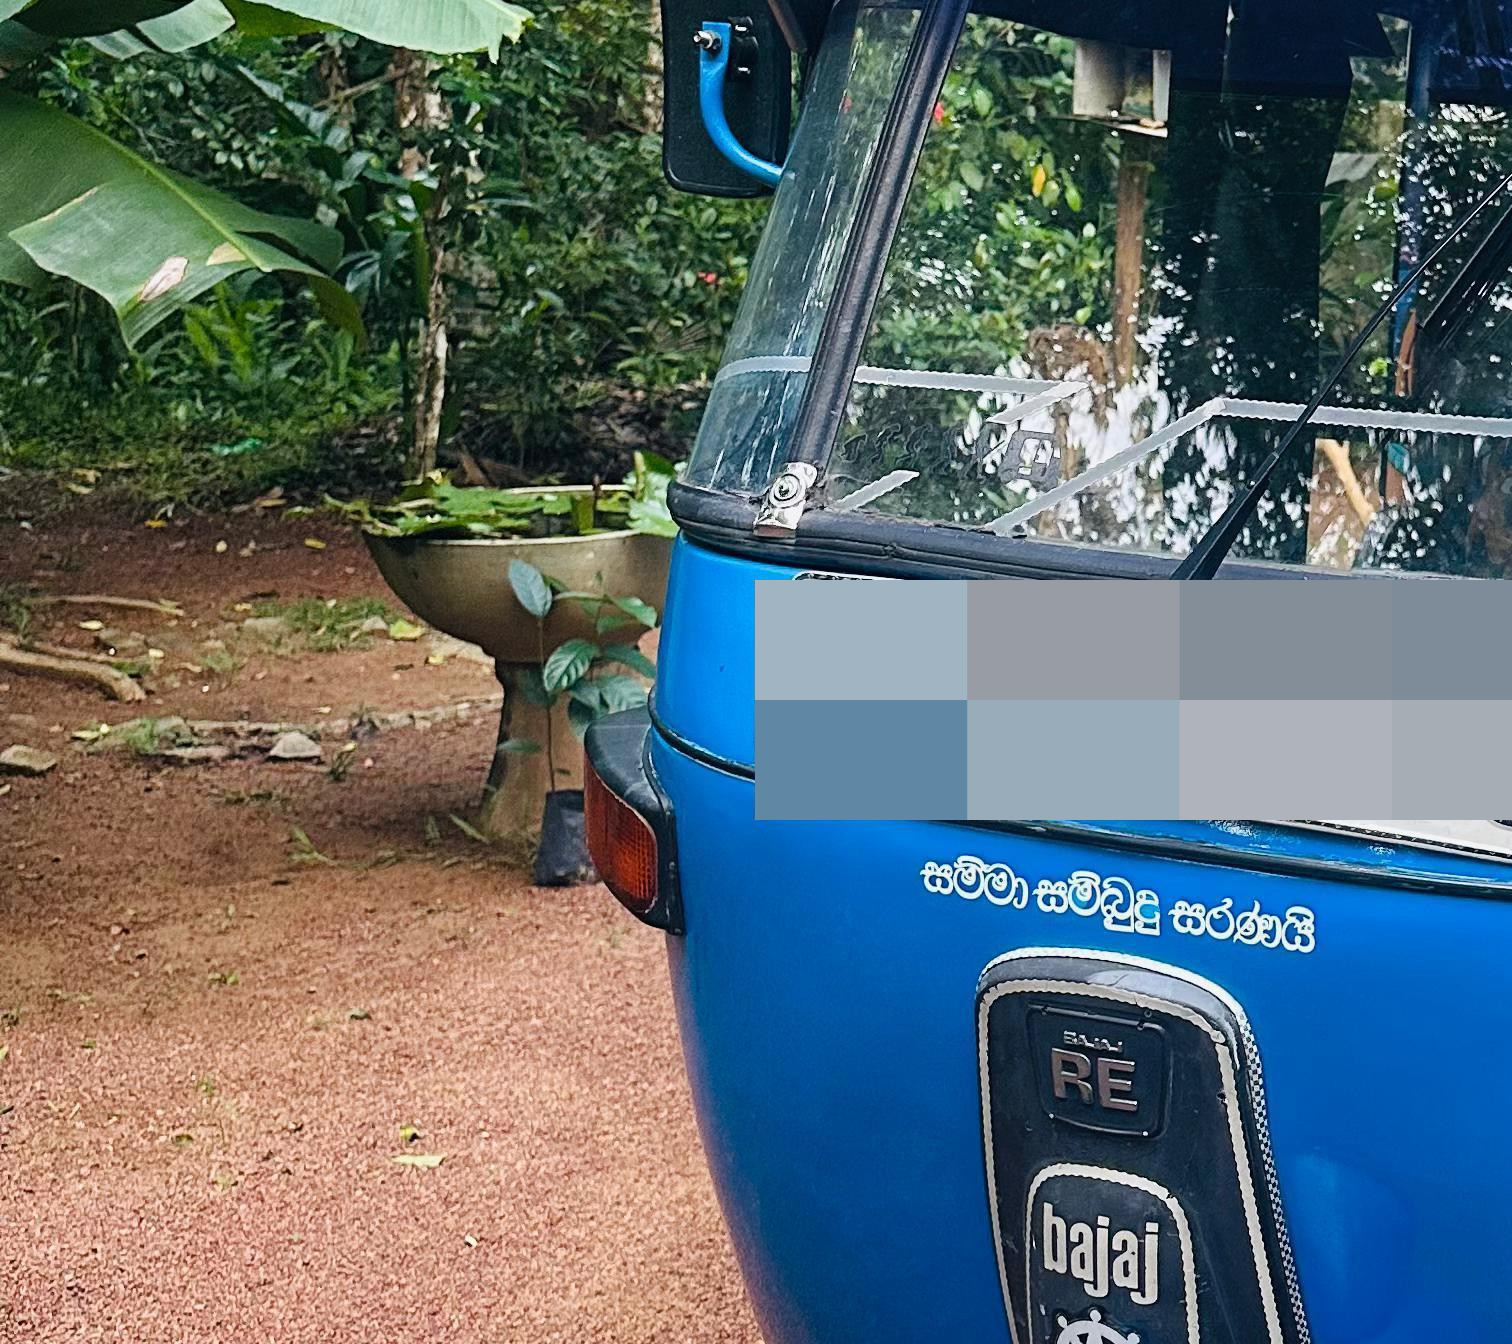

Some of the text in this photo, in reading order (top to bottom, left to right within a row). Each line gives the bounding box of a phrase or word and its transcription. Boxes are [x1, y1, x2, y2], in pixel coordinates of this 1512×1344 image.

[920, 855, 1316, 954] සම්මා සම්බුදු සරණයි
[1051, 1047, 1138, 1112] RE
[1043, 1201, 1159, 1305] bajaj
